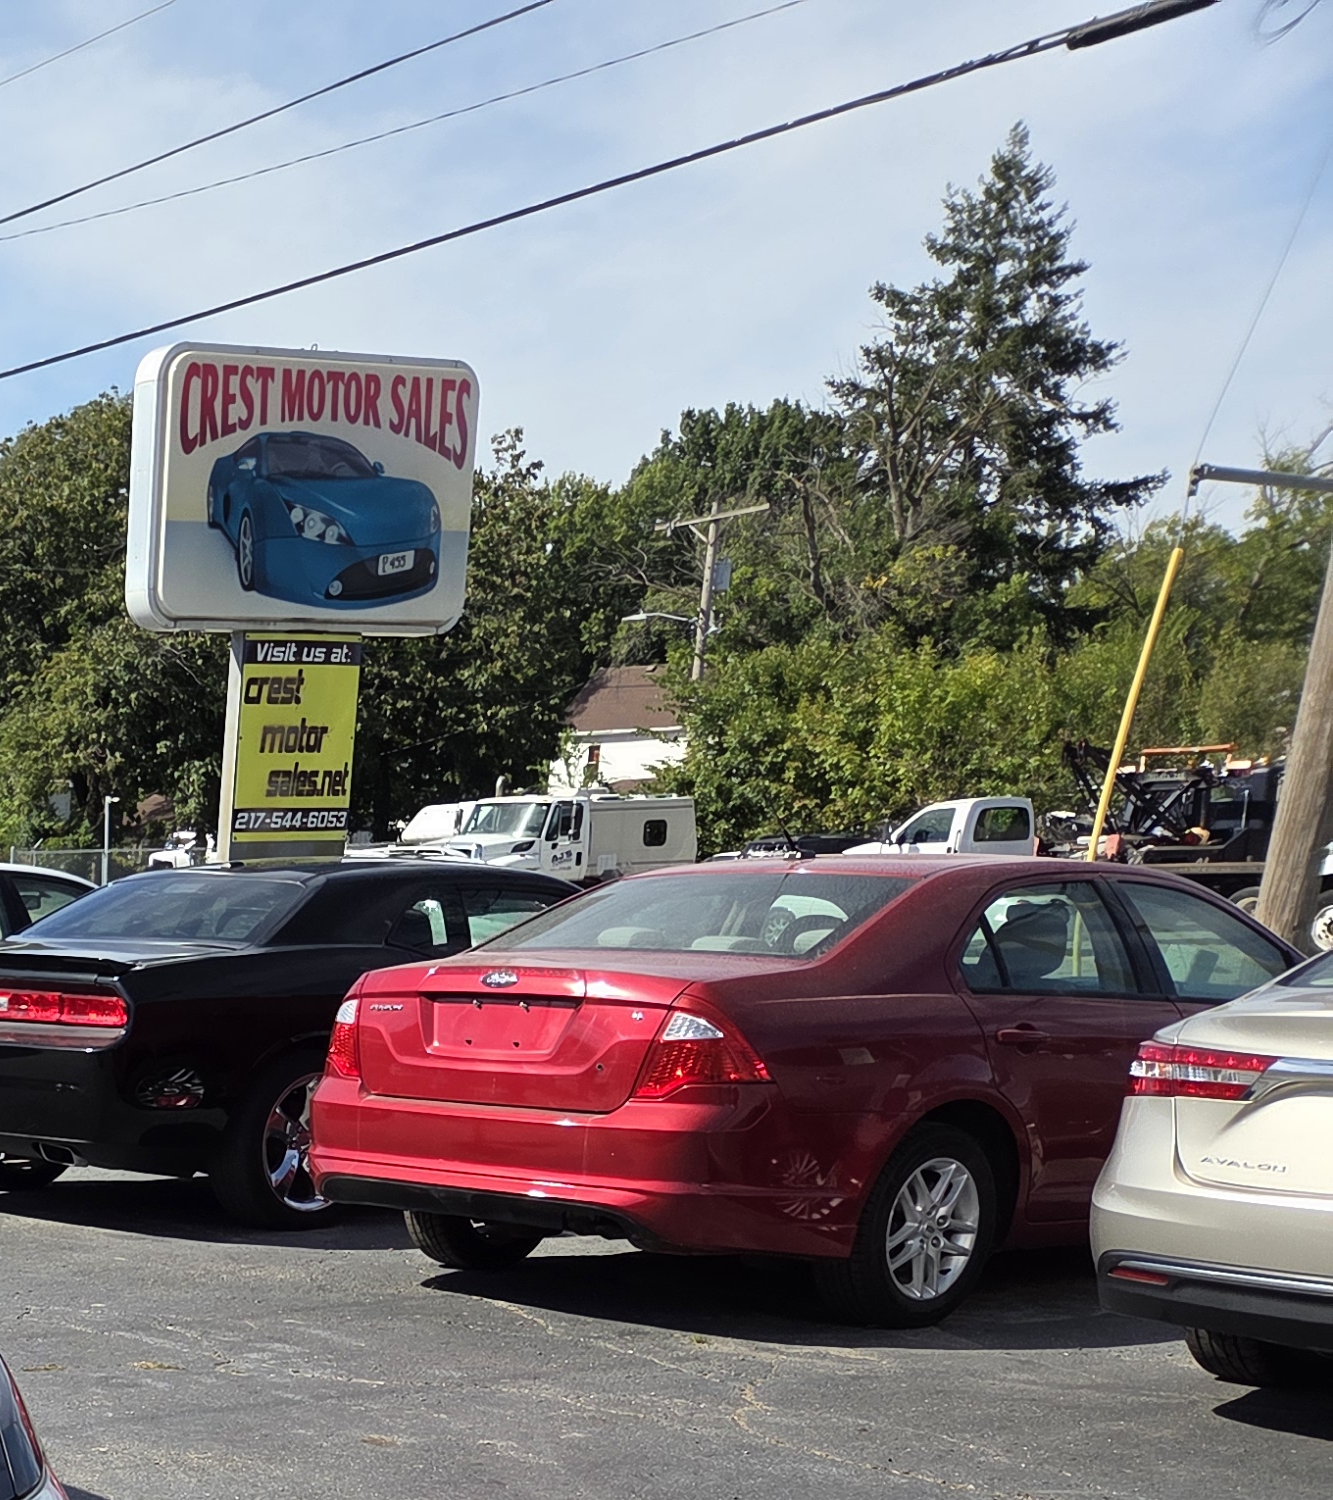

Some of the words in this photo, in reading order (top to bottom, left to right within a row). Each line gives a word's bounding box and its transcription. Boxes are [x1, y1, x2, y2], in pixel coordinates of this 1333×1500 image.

[180, 362, 275, 455] CREST
[281, 368, 381, 429] MOTOR
[389, 374, 471, 470] SALES
[256, 642, 298, 662] Visit
[301, 647, 326, 662] us
[330, 645, 352, 663] at:
[243, 668, 305, 705] crest
[258, 717, 329, 754] motor
[265, 762, 350, 798] sales.net
[235, 811, 347, 829] 217-544-6053
[1200, 1157, 1287, 1173] AVALON
